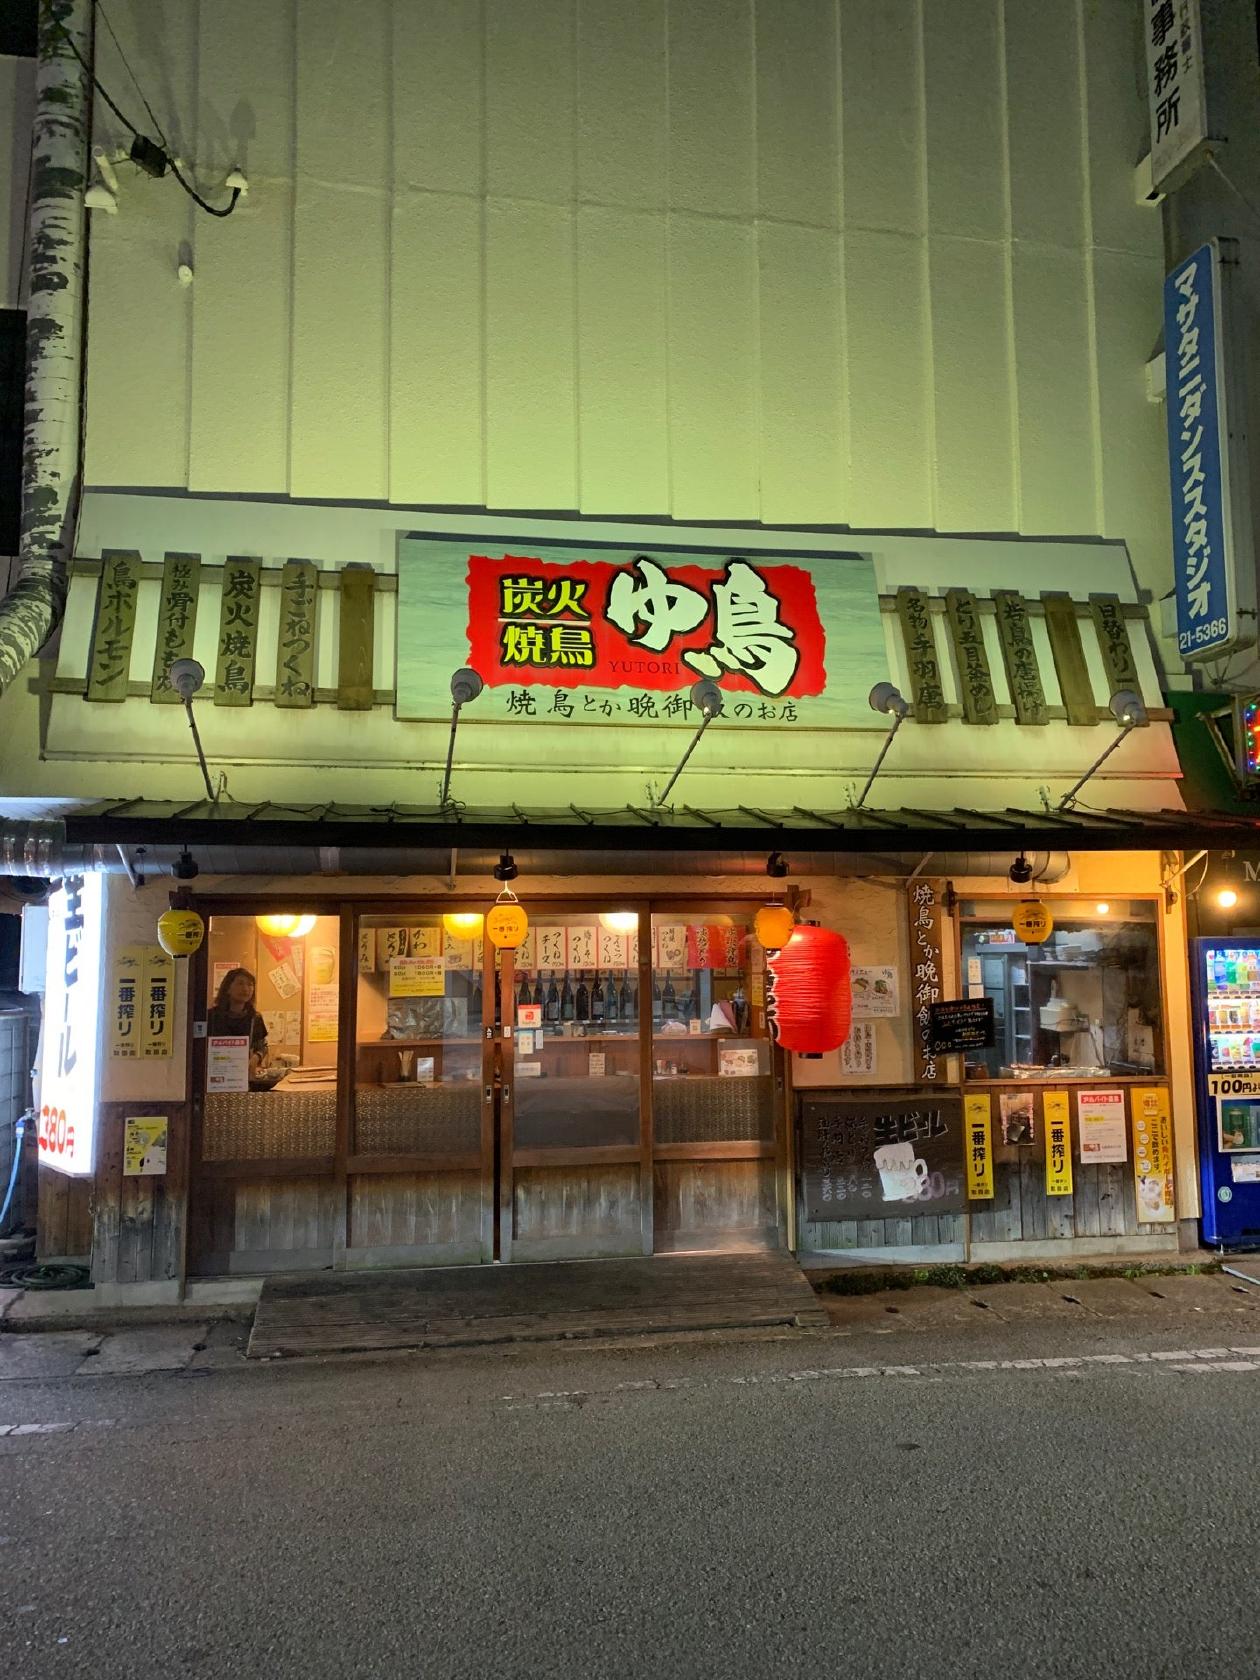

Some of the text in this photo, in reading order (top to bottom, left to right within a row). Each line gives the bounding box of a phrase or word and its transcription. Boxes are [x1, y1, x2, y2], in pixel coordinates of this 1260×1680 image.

[1175, 262, 1211, 619] マサタニダンススタジオ
[96, 560, 137, 686] 鳥ホルモン
[501, 577, 589, 618] 炭火
[606, 557, 799, 697] ゆ鳥
[220, 568, 254, 695] 炭火焼鳥
[281, 571, 314, 697] 手ごねつくね
[502, 626, 594, 667] 焼鳥
[906, 597, 942, 710] 名物手羽唐
[1179, 618, 1227, 649] 21-5366
[608, 660, 681, 676] YUTORI
[57, 873, 85, 1078] 生ビール
[118, 978, 136, 1036] 一番搾り
[149, 977, 168, 1036] 一番搾り
[971, 1123, 986, 1177] 一番搾り
[1050, 1120, 1065, 1174] 一番搾り
